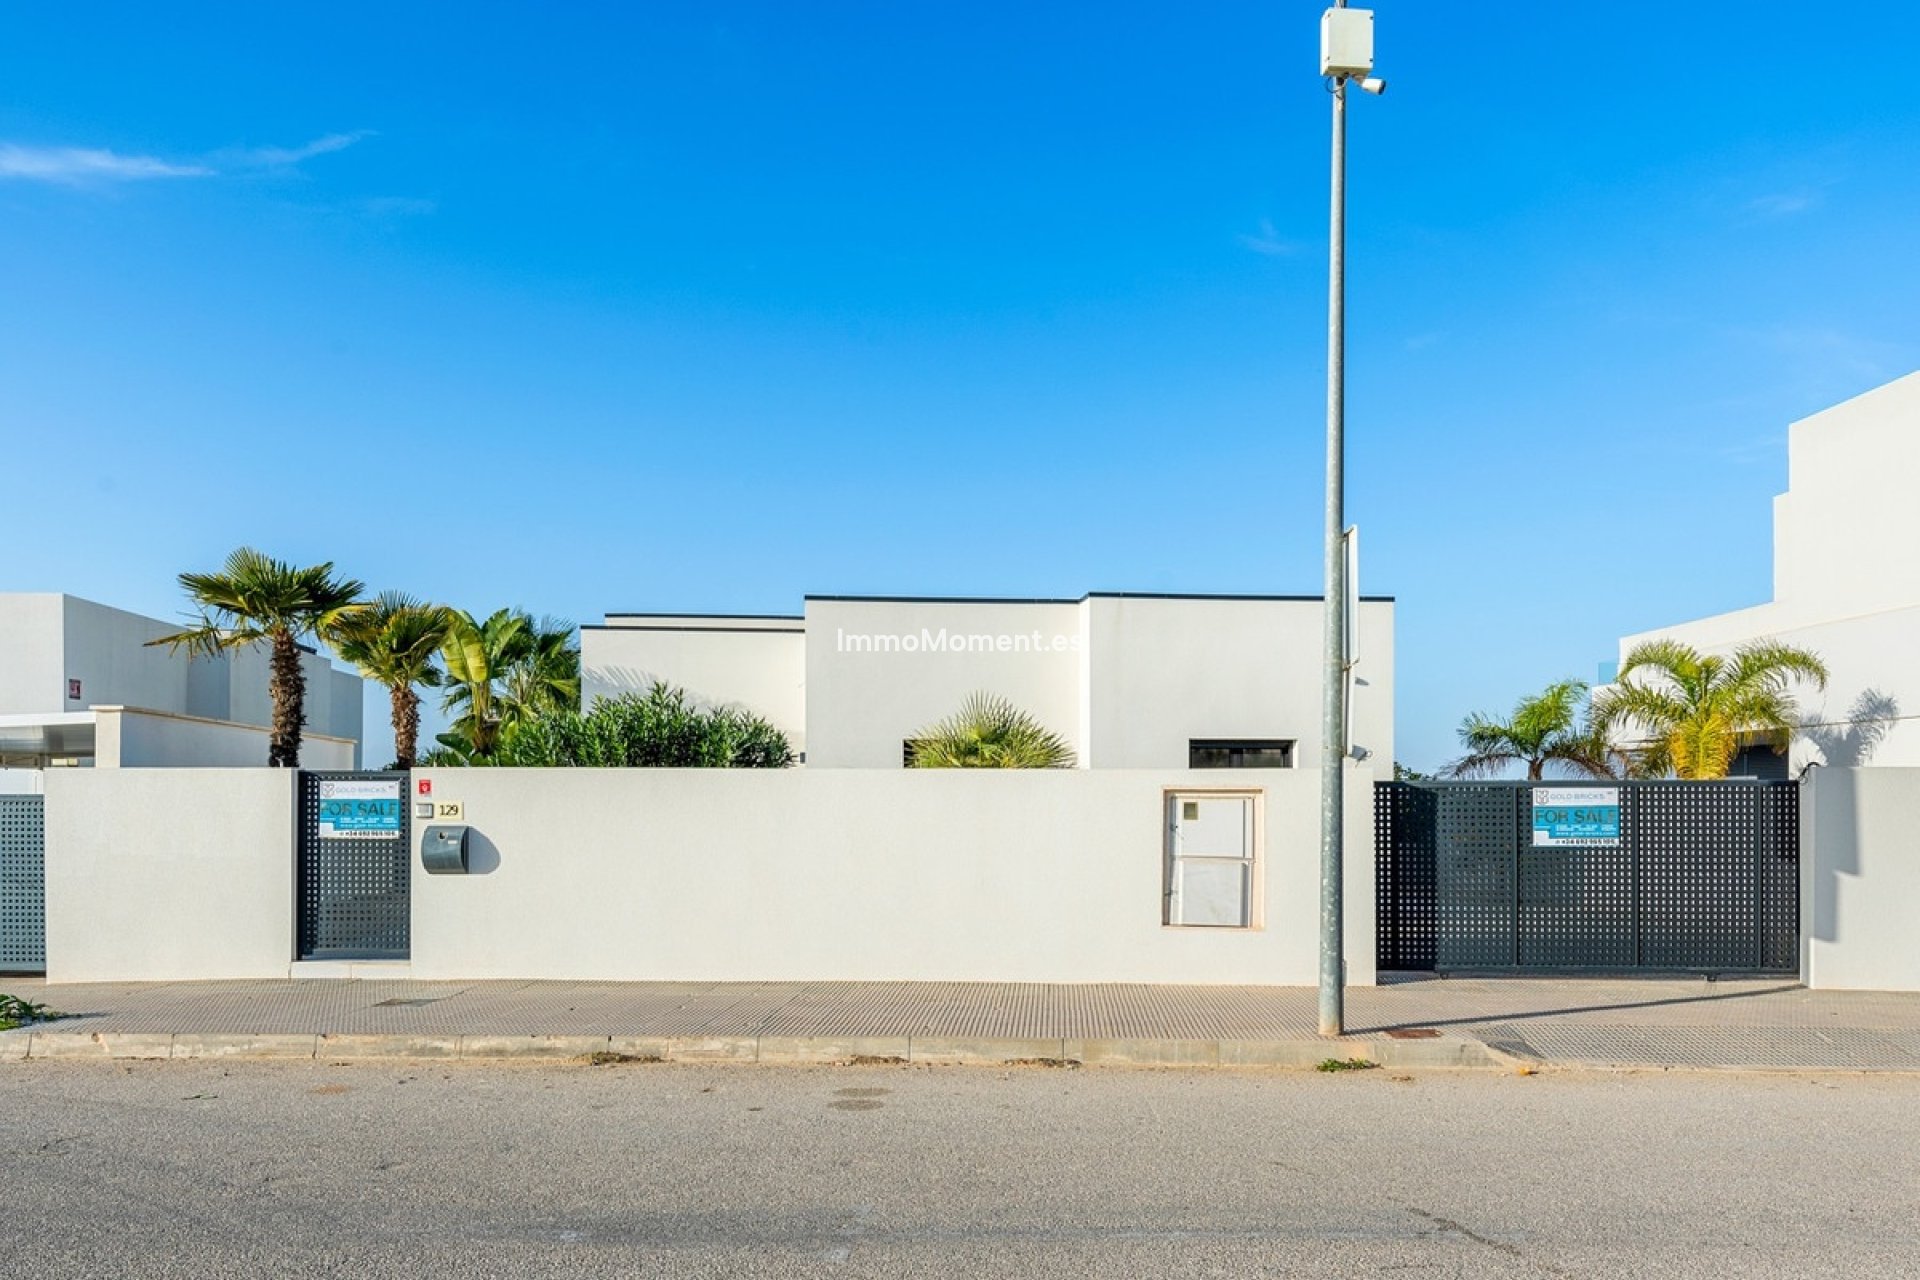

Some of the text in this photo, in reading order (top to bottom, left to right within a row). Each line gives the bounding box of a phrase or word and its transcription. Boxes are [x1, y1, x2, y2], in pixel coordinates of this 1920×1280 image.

[321, 802, 397, 816] FOR SALE
[439, 804, 459, 816] 129
[1535, 809, 1616, 824] FOR SALE
